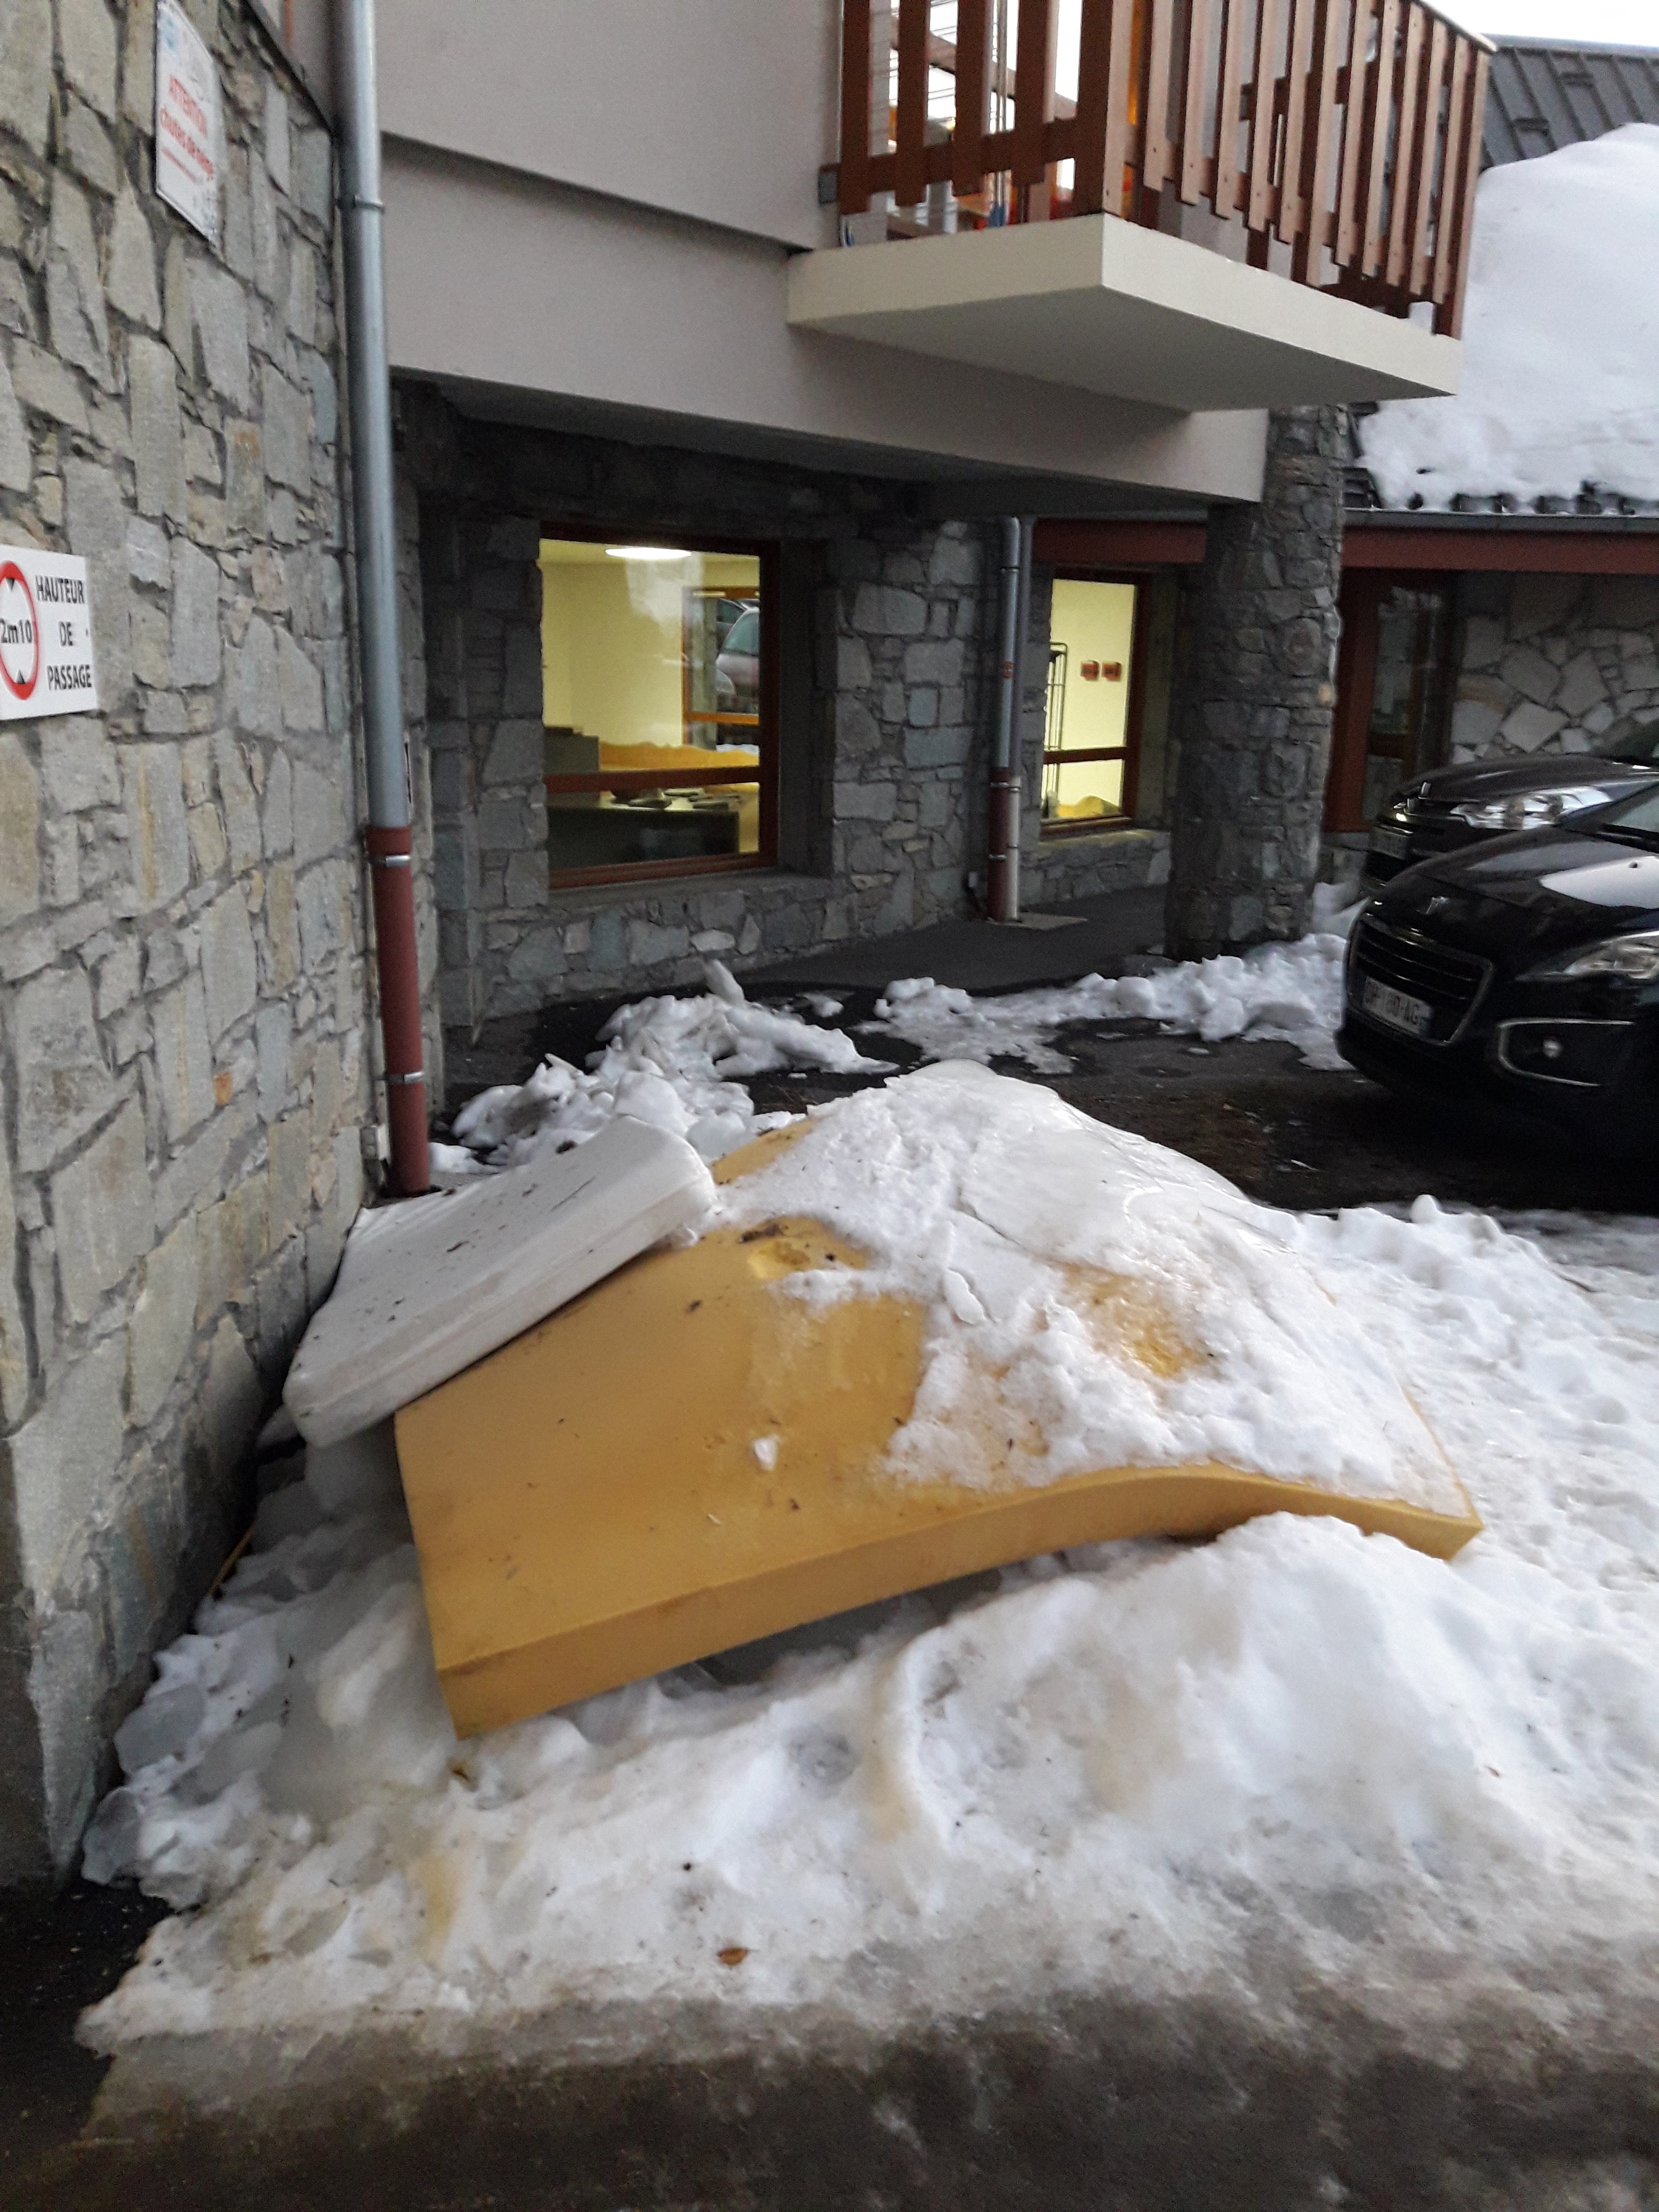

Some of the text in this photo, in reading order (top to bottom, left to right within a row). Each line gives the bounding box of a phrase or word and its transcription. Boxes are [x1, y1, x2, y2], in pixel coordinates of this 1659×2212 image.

[35, 576, 84, 603] HAUTEUR
[0, 618, 33, 643] 2m10
[59, 622, 73, 646] DE
[47, 664, 92, 690] PASSAGE
